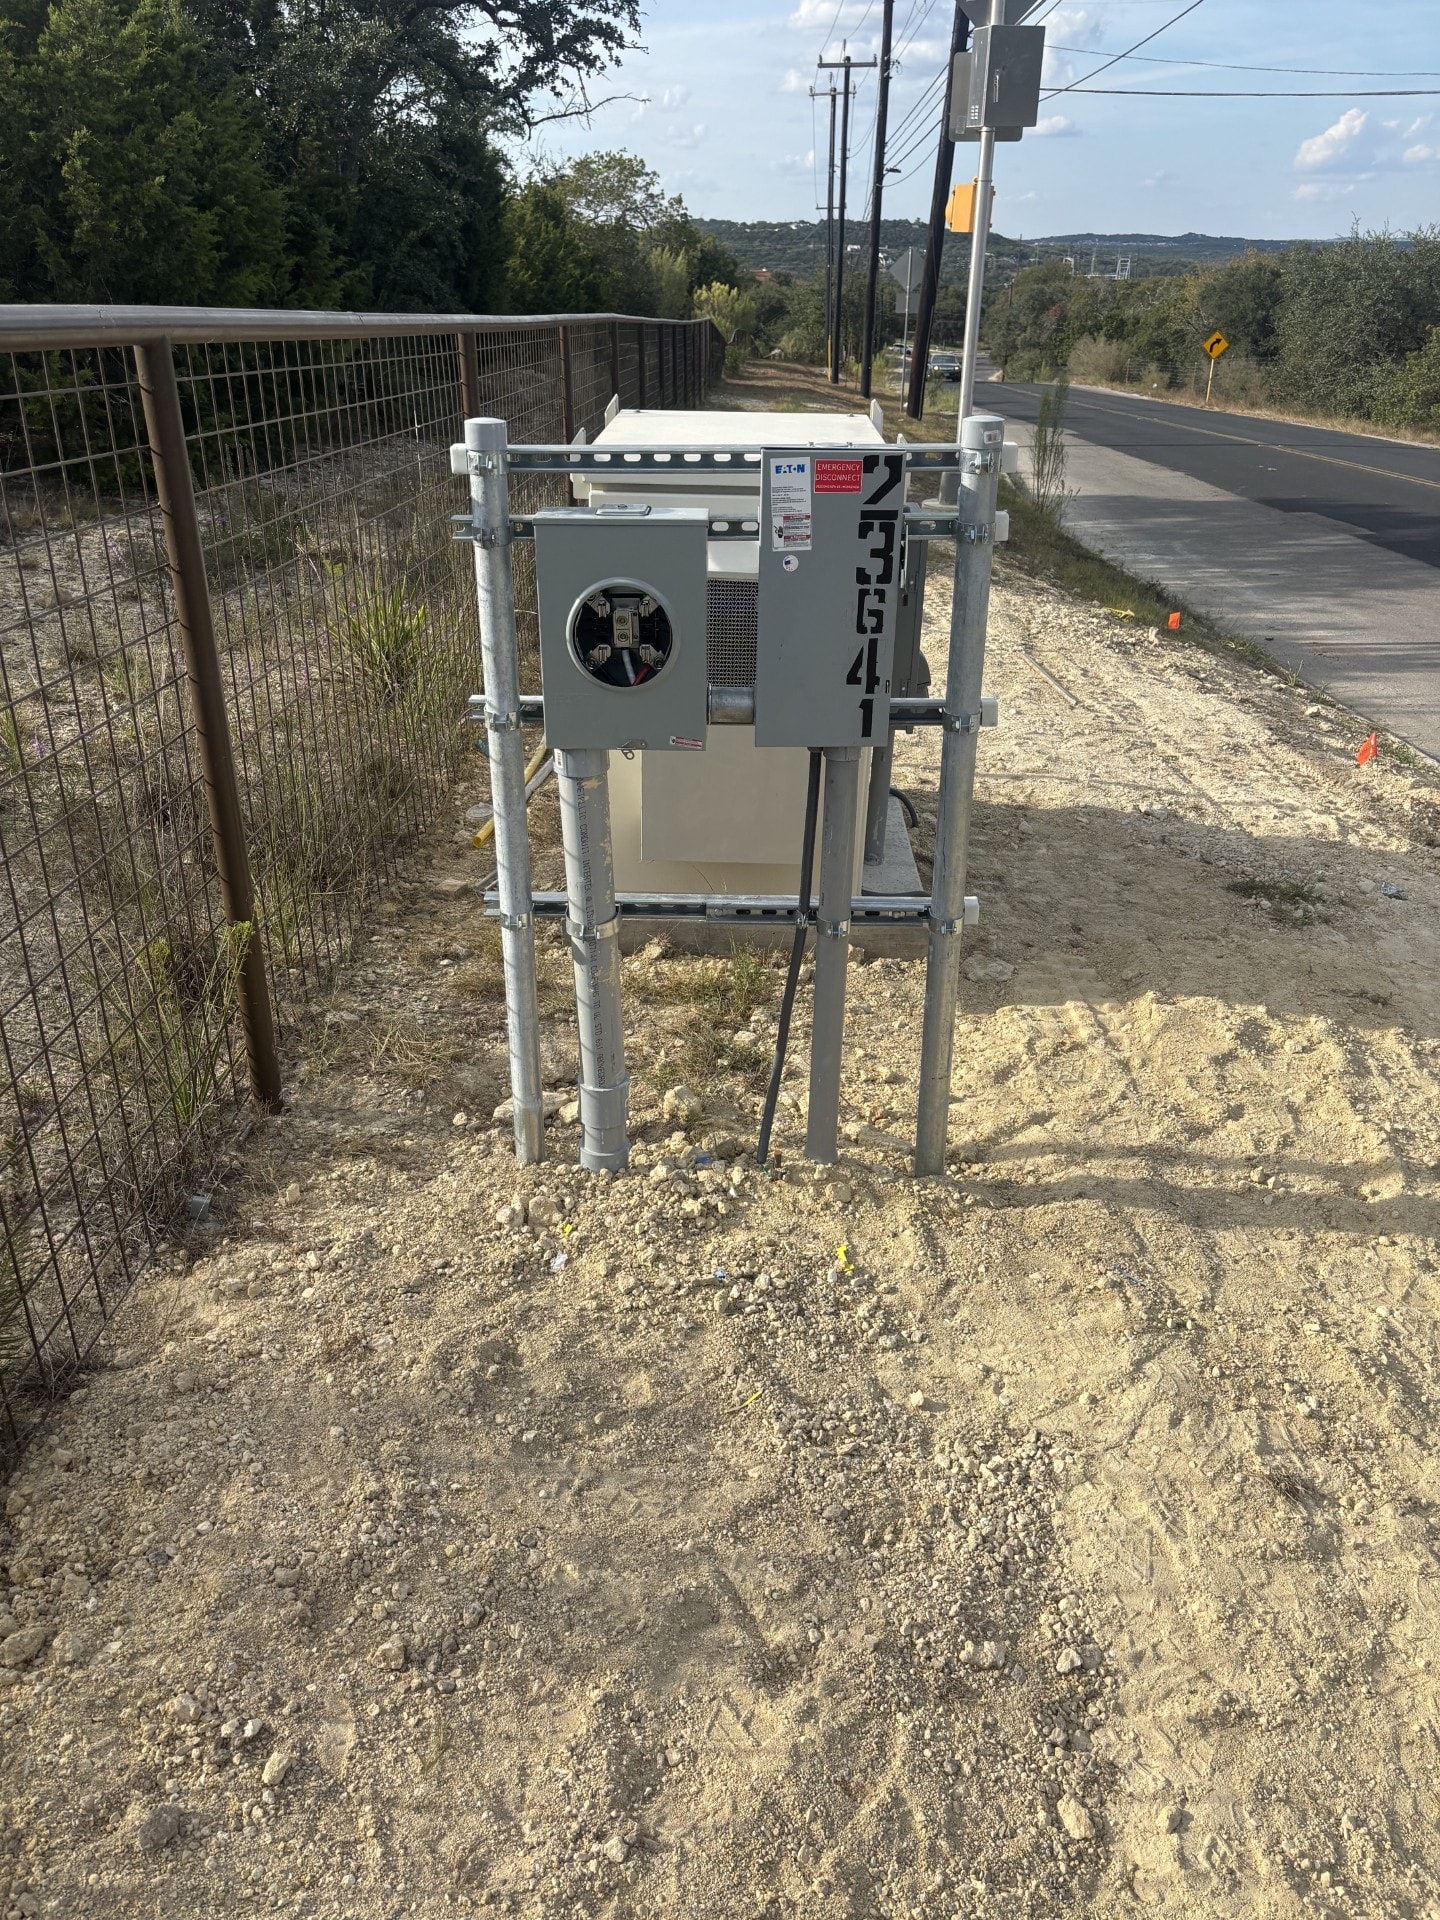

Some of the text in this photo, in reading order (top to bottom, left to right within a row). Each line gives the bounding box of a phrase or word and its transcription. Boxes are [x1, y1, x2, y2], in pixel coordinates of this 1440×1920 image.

[817, 463, 860, 471] EMERGENCY
[815, 473, 860, 481] DISCONNECT
[846, 454, 903, 738] 23641
[580, 824, 590, 855] CONDUIT
[583, 859, 593, 895] INTERTEK
[593, 1000, 601, 1009] TO
[594, 1011, 602, 1021] UL
[595, 1023, 603, 1036] STD
[596, 1038, 604, 1050] 651
